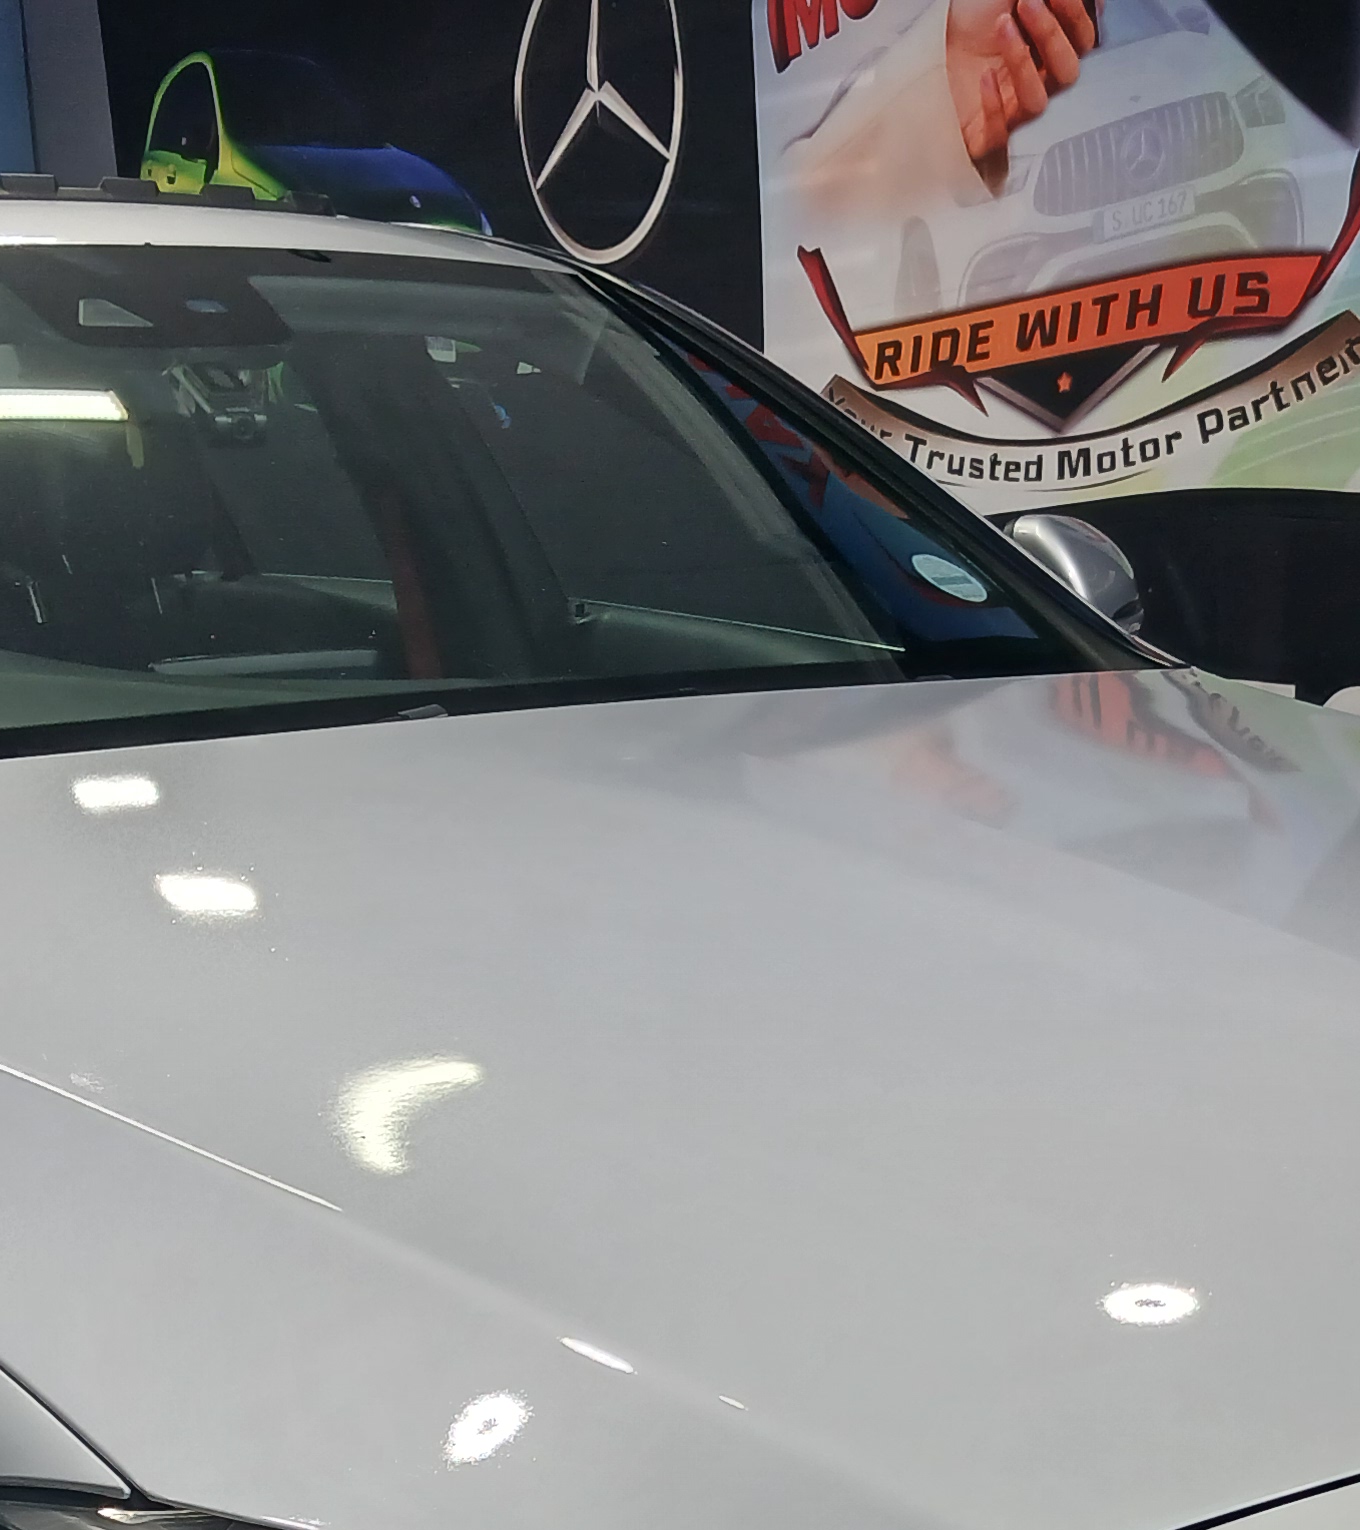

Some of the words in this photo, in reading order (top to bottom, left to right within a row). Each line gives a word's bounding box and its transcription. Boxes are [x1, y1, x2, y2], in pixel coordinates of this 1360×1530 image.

[873, 316, 992, 379] RIDE
[1015, 282, 1175, 350] WITH
[1187, 271, 1271, 320] US
[904, 432, 1044, 482] Trusted
[1056, 431, 1185, 482] Motor
